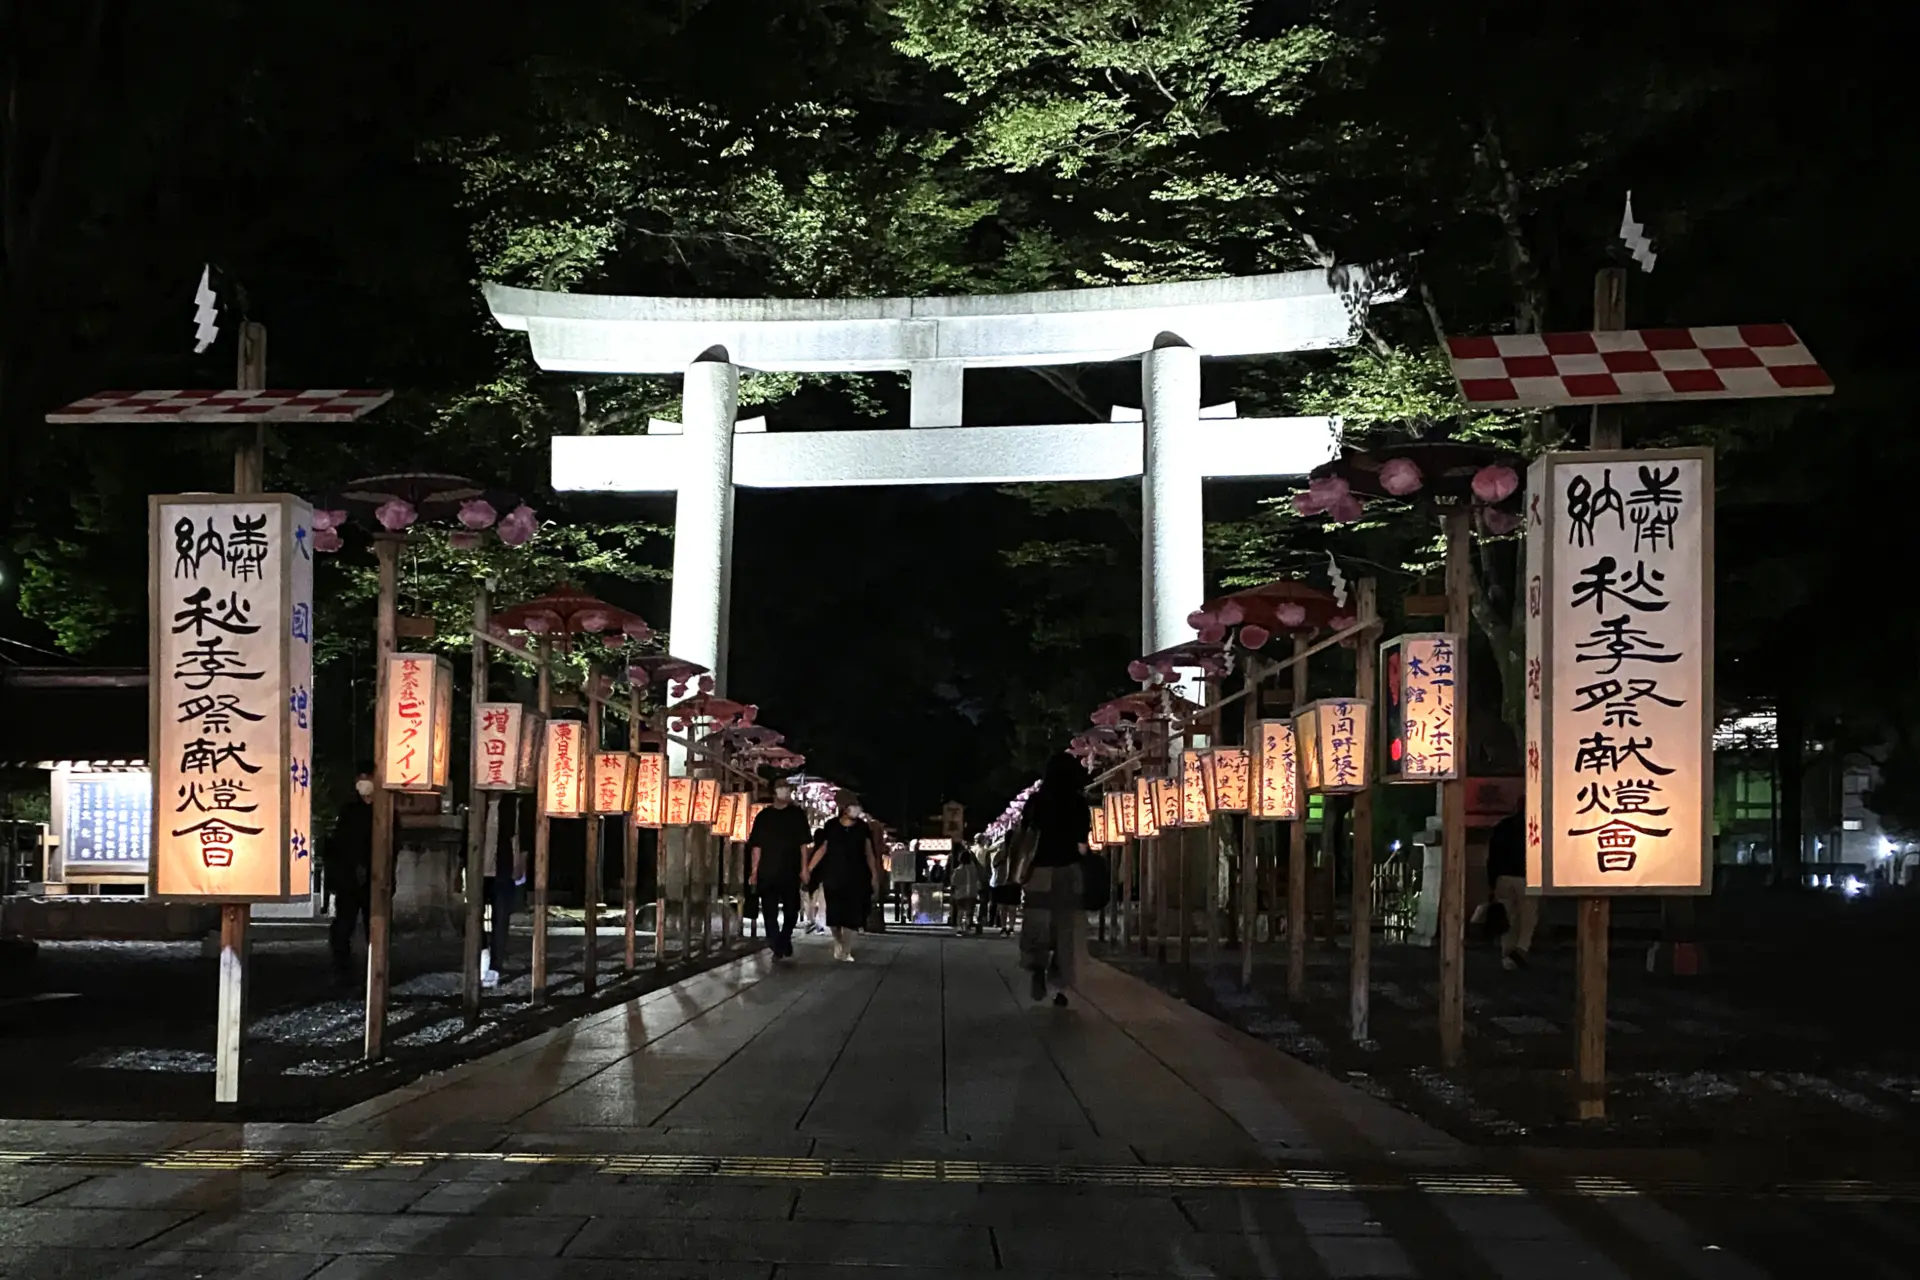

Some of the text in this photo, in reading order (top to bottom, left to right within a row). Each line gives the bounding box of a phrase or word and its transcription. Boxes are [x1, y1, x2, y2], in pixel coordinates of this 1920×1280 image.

[482, 708, 509, 785] 増田屋
[1427, 639, 1454, 777] 府中アーバンホテル
